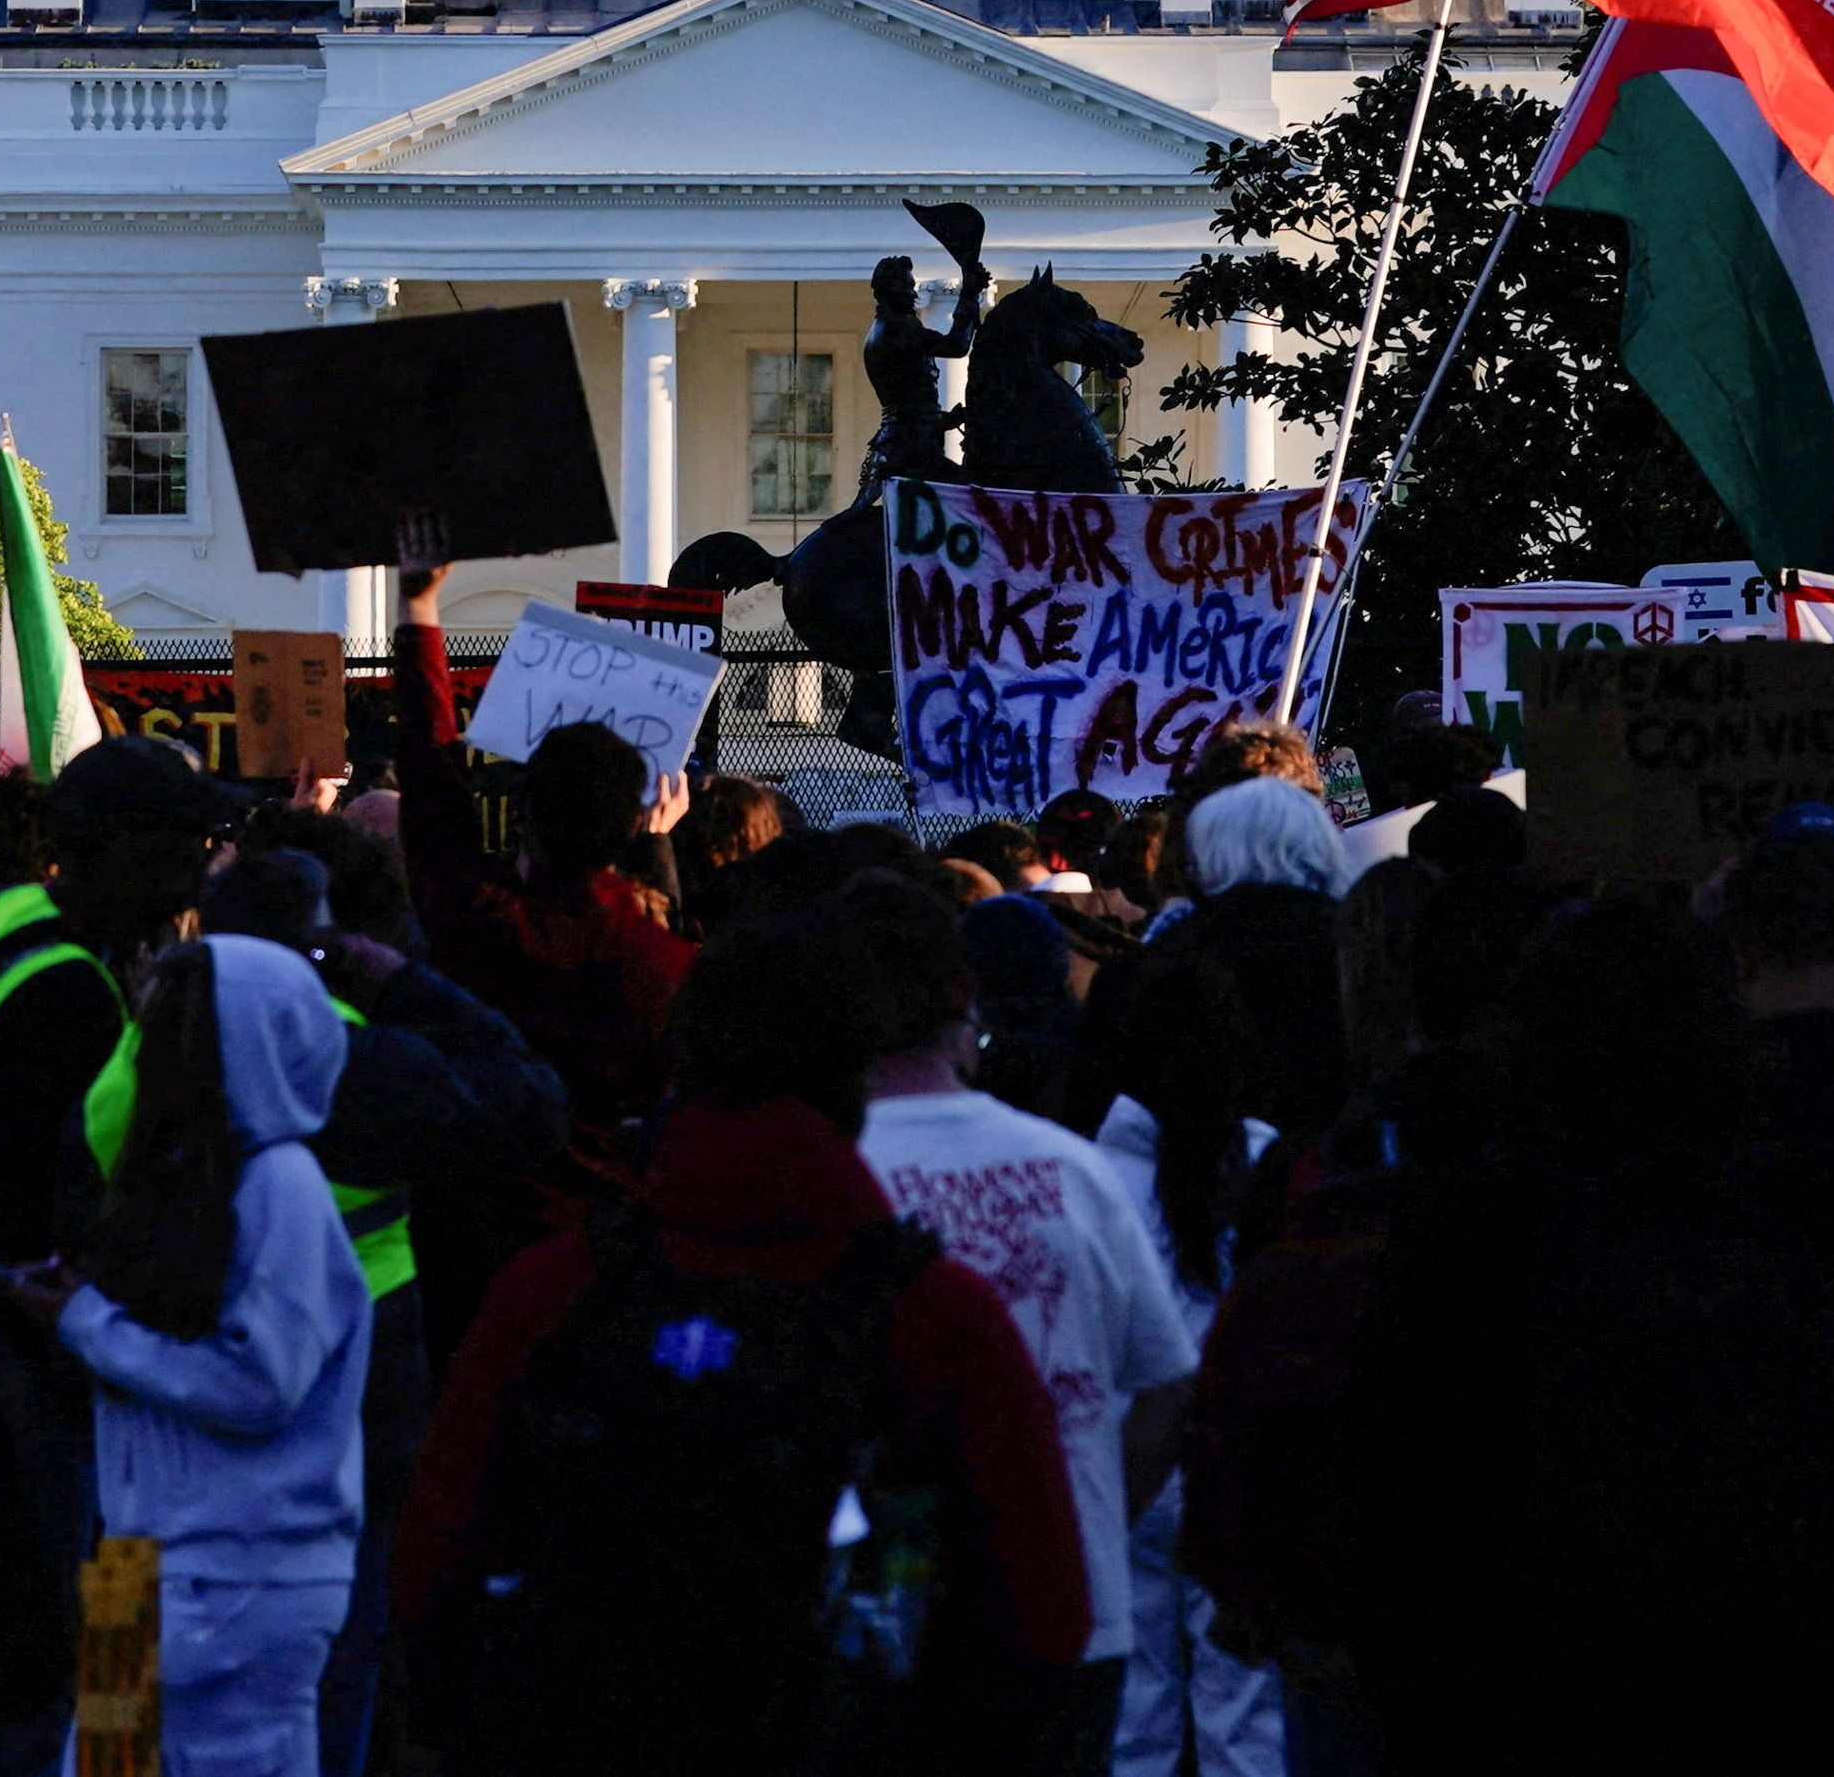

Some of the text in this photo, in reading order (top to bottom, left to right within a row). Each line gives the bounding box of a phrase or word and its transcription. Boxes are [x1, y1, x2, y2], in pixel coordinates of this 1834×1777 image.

[970, 484, 1130, 587] WAR
[1144, 483, 1360, 609] CRIMES
[513, 627, 636, 685] STOP
[895, 563, 1086, 673] MAKE
